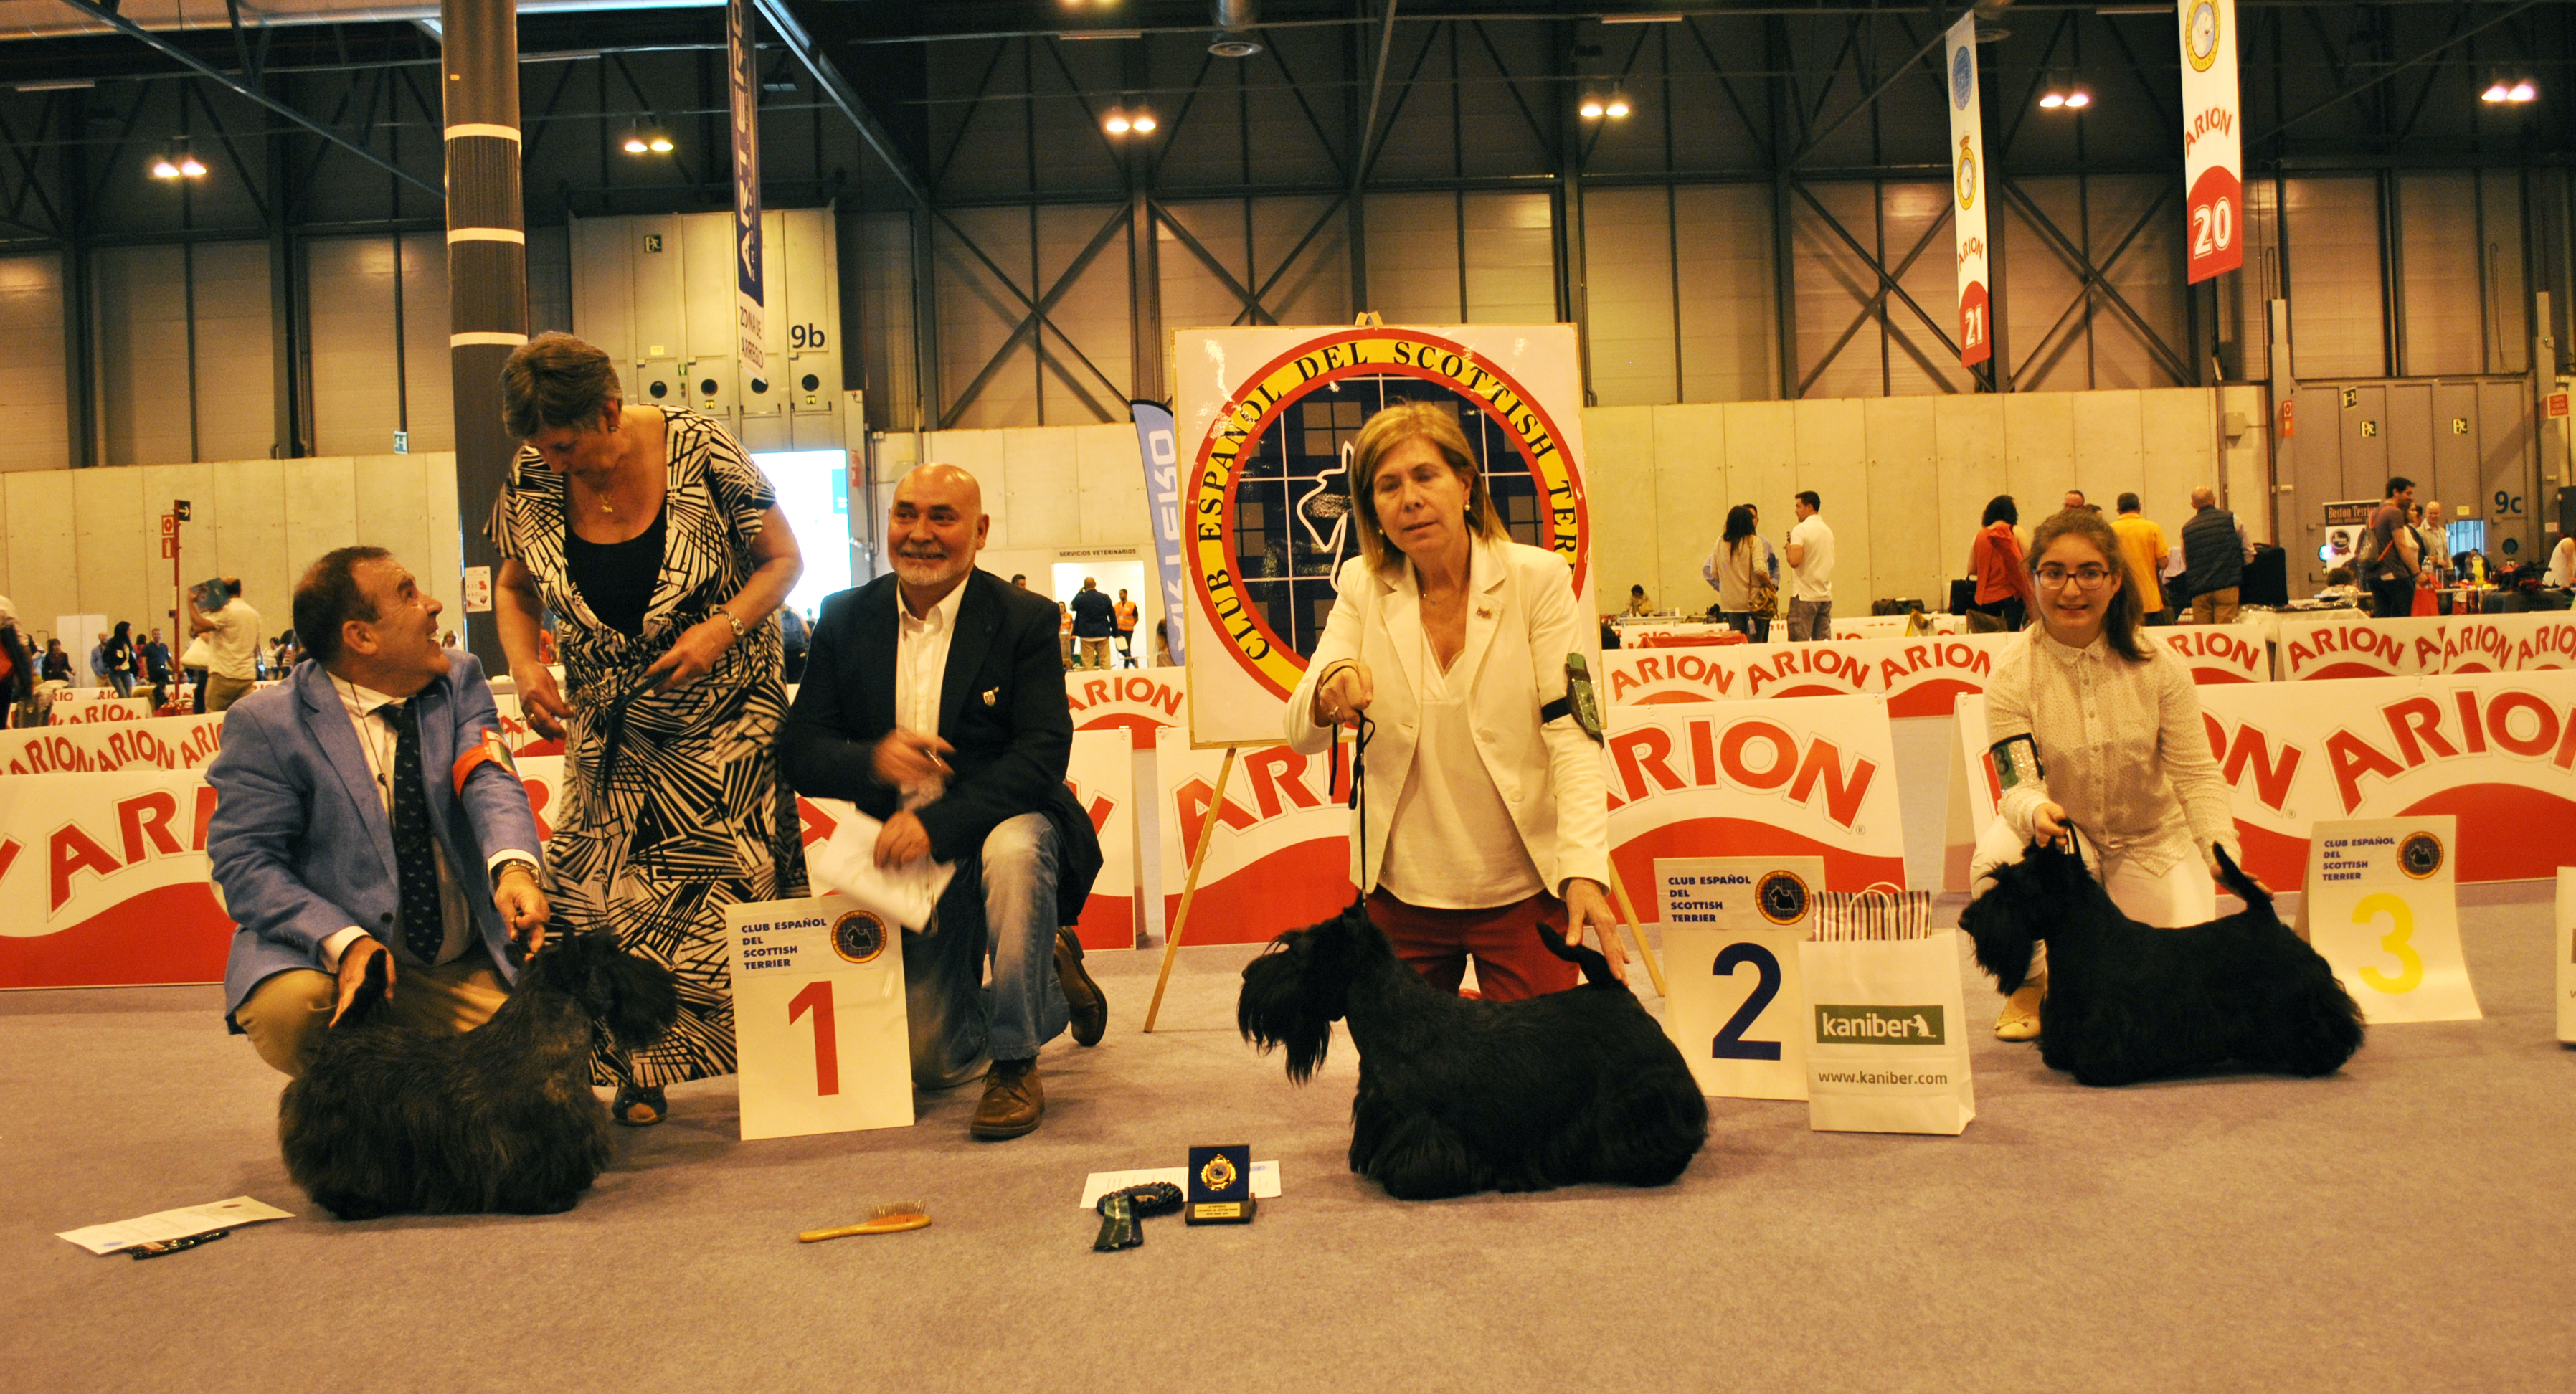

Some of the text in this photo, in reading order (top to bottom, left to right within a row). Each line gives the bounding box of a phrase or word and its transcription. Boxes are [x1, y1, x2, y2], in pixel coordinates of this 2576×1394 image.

[2185, 106, 2232, 160] ARION
[2193, 196, 2232, 260] 20
[1959, 237, 1984, 272] ARION
[790, 323, 825, 349] 9b
[1965, 303, 1983, 349] 21
[1206, 569, 1271, 660] CLUB
[1294, 341, 1368, 382] DEL
[1393, 341, 1557, 460] SCOTTISH
[2494, 490, 2522, 514] 9c
[1880, 643, 1991, 691] ARION
[2166, 632, 2260, 673] RION
[2288, 626, 2405, 674] ARION
[2443, 624, 2513, 671] ARION
[2516, 624, 2576, 672] ARIO
[1611, 655, 1736, 702] ARION
[1747, 648, 1870, 697] ARION
[97, 729, 175, 772] ARION
[180, 722, 223, 769] ARI
[1607, 720, 1877, 829] RION
[1176, 745, 1351, 871] ARI
[49, 786, 218, 914] ARI
[2352, 836, 2395, 847] ESPAÑOL
[1668, 874, 1751, 886] CLUB ESPAÑOL
[2322, 873, 2362, 881] TERRIER
[2323, 861, 2368, 870] SCOTTISH
[1670, 889, 1690, 898] DEL
[1670, 901, 1723, 910] SCOTTISH
[741, 917, 827, 934] CLUB ESPAÑOL
[742, 937, 764, 946] DEL
[2351, 892, 2423, 995] 3
[743, 945, 798, 958] SCOTTISH
[744, 959, 791, 970] TERRIER
[1711, 942, 1782, 1061] 2
[787, 980, 840, 1096] 1
[1822, 1012, 1912, 1038] kaniber
[1818, 1071, 1948, 1085] www.kaniber.com
